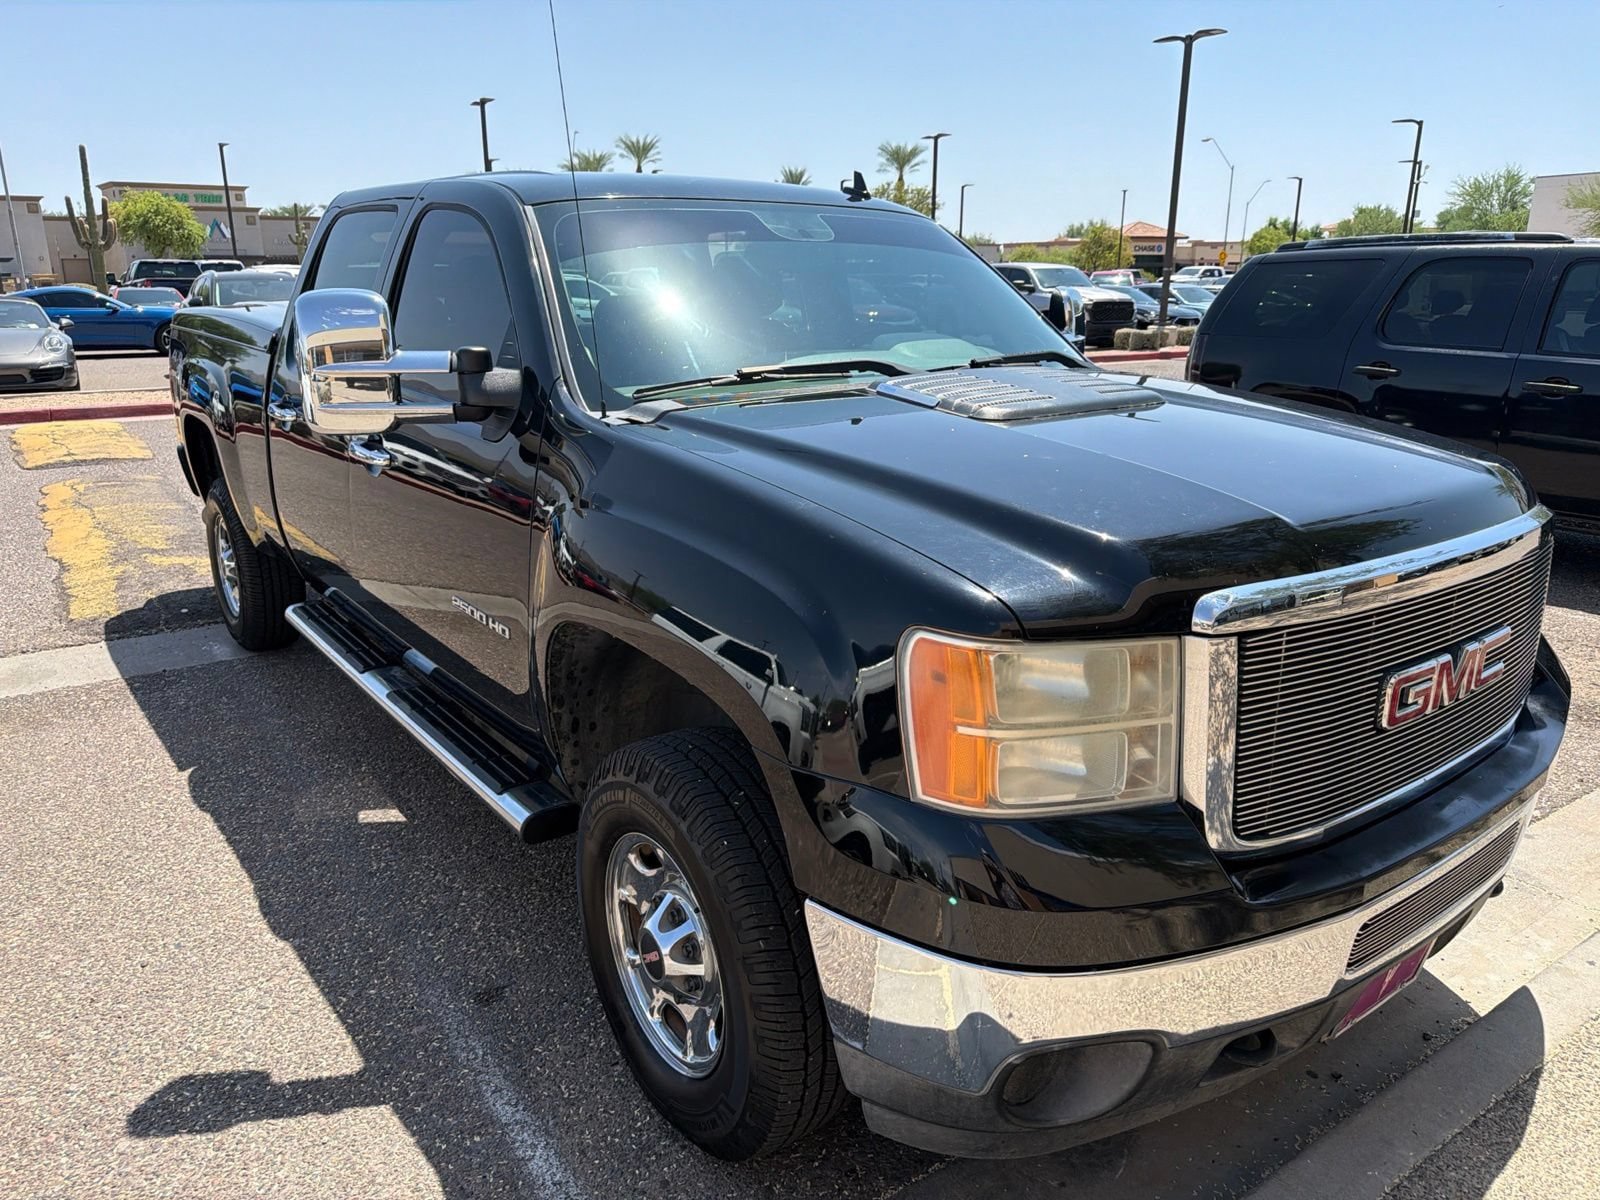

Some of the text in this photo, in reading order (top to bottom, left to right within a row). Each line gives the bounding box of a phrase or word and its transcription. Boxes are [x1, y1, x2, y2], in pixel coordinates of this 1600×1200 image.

[1134, 244, 1155, 252] CHASE
[452, 596, 510, 639] 2500 HD
[1381, 625, 1512, 731] GMC
